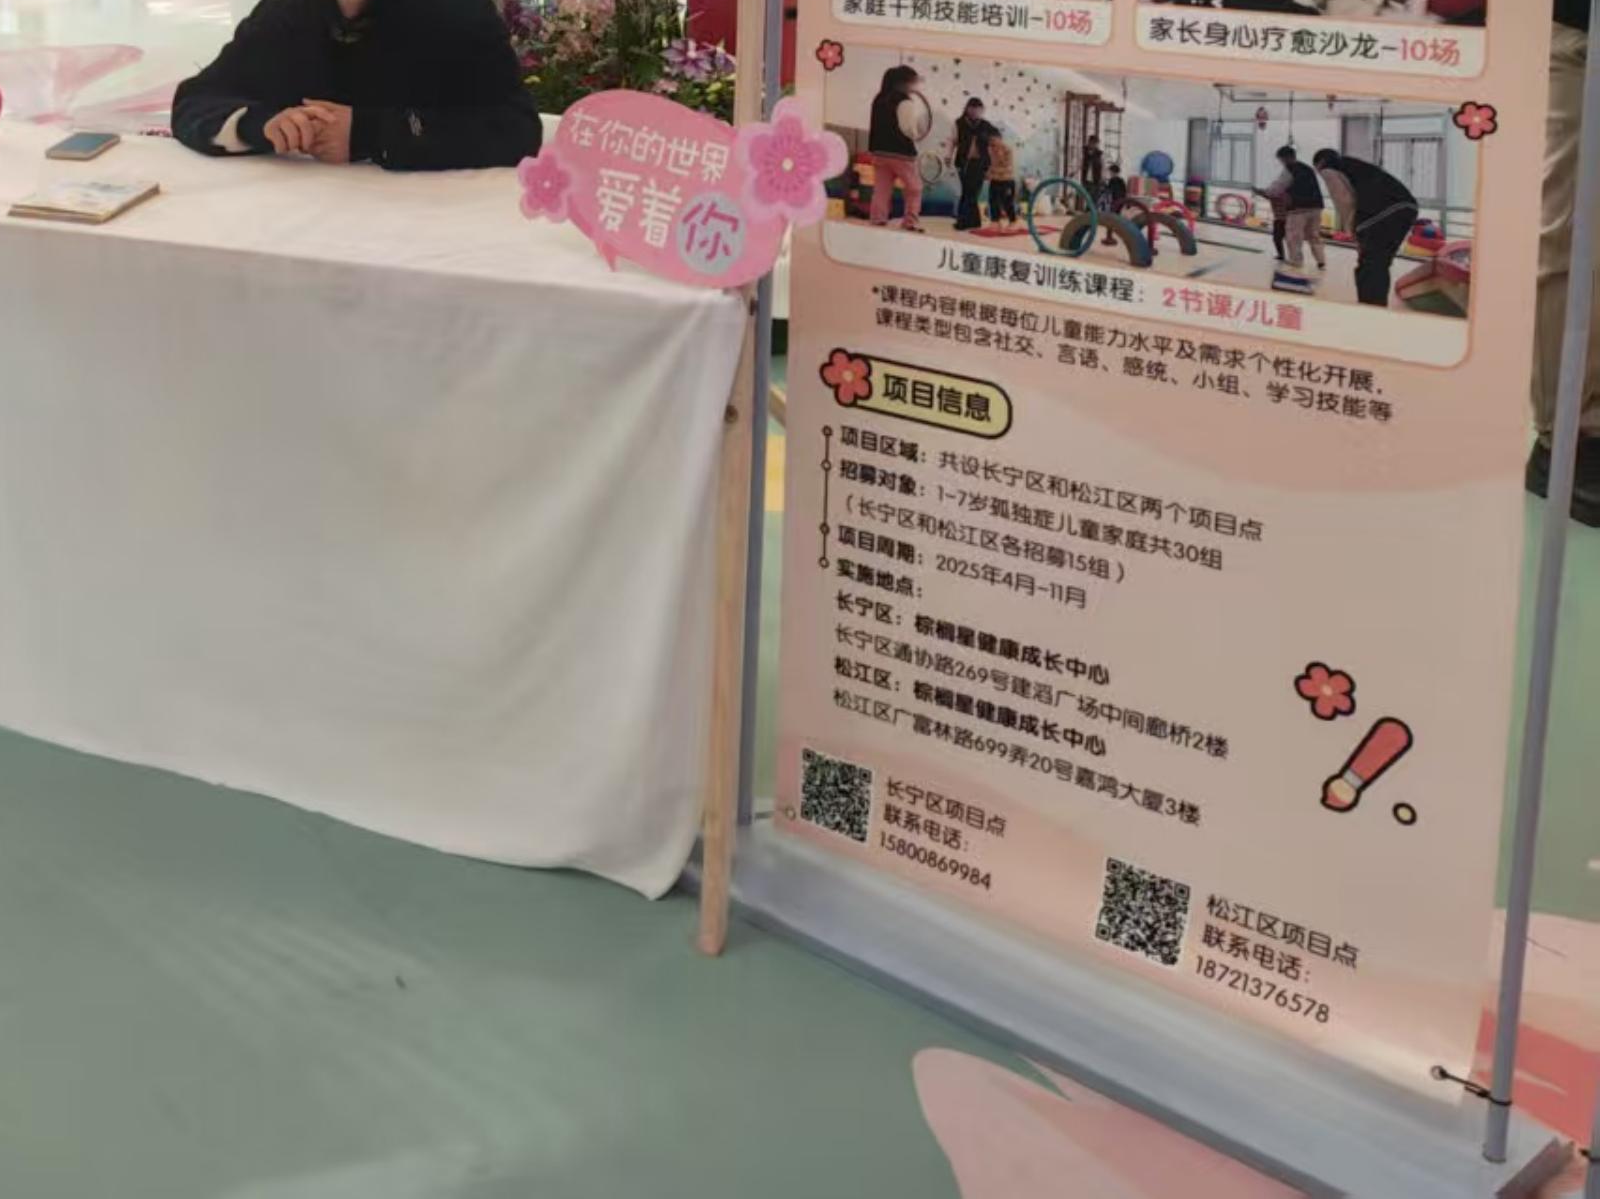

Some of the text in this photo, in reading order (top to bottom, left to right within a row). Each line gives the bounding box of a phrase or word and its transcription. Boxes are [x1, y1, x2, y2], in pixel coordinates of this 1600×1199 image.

[1149, 16, 1461, 68] 家长身心疗愈沙龙-10场
[569, 107, 731, 184] 在你的世界
[596, 166, 740, 260] 爱着你
[883, 372, 993, 424] 项目信息
[886, 776, 1006, 838] 长宁区项目点
[878, 830, 992, 890] 15800869984
[1206, 893, 1359, 970] 松江区项目点
[1195, 955, 1331, 1024] 18721376578
